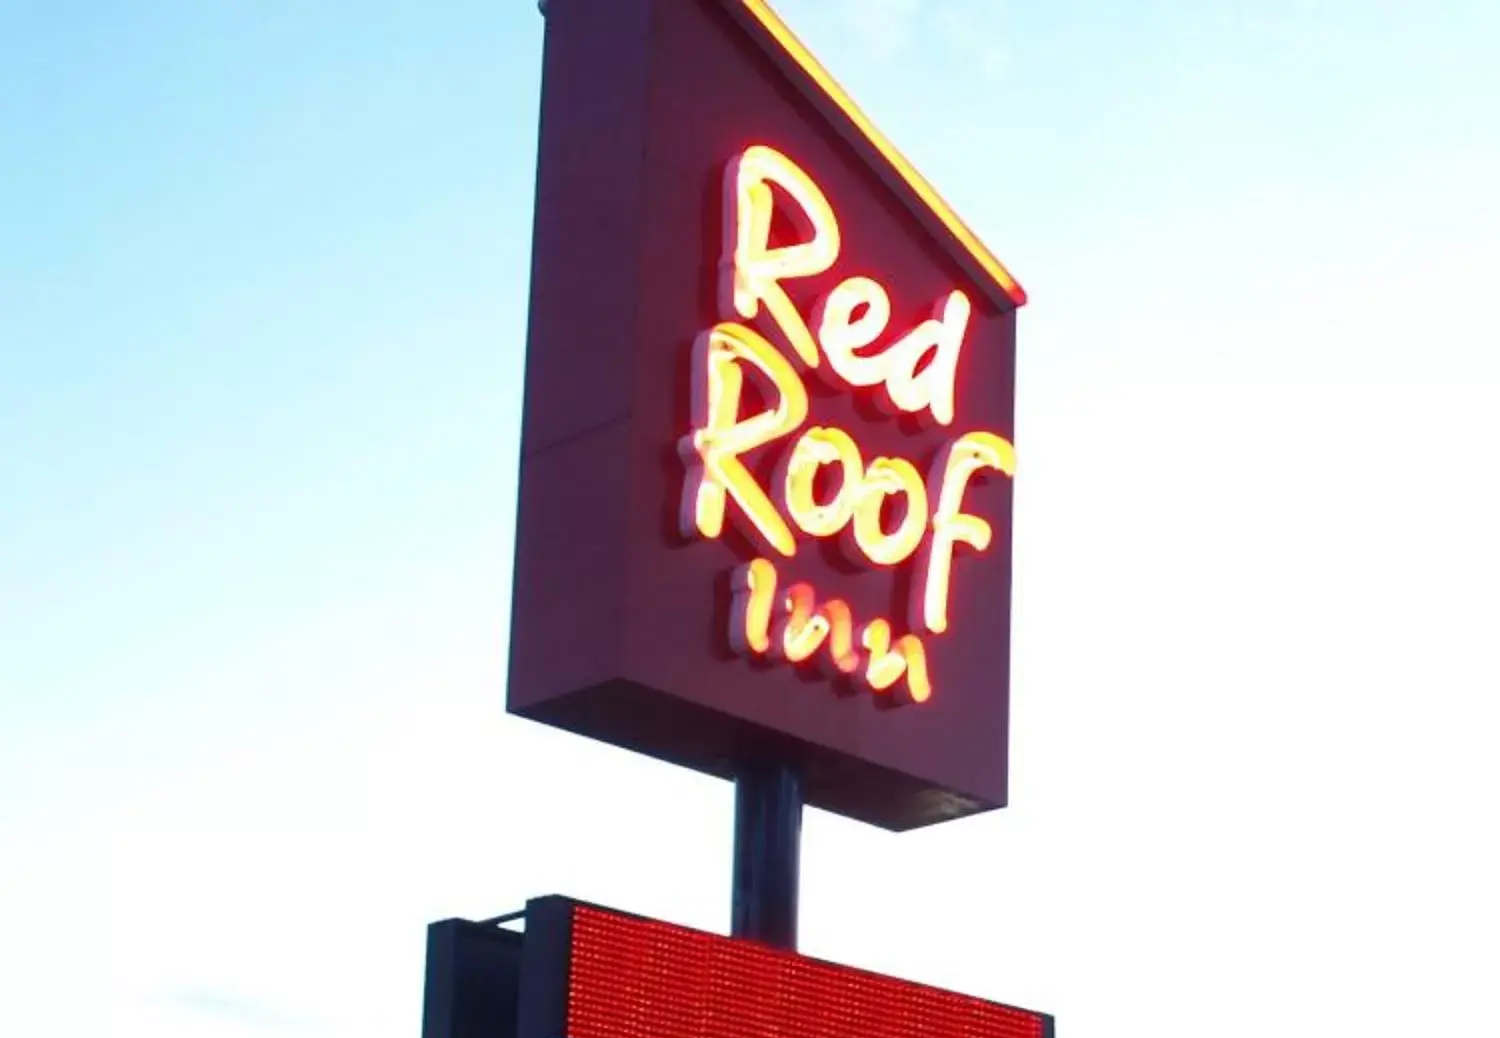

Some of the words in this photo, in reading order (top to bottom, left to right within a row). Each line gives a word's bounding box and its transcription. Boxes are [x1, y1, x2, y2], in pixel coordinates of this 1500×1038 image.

[733, 145, 973, 426] Red
[694, 322, 1018, 633] Roof
[742, 557, 933, 703] Inn
